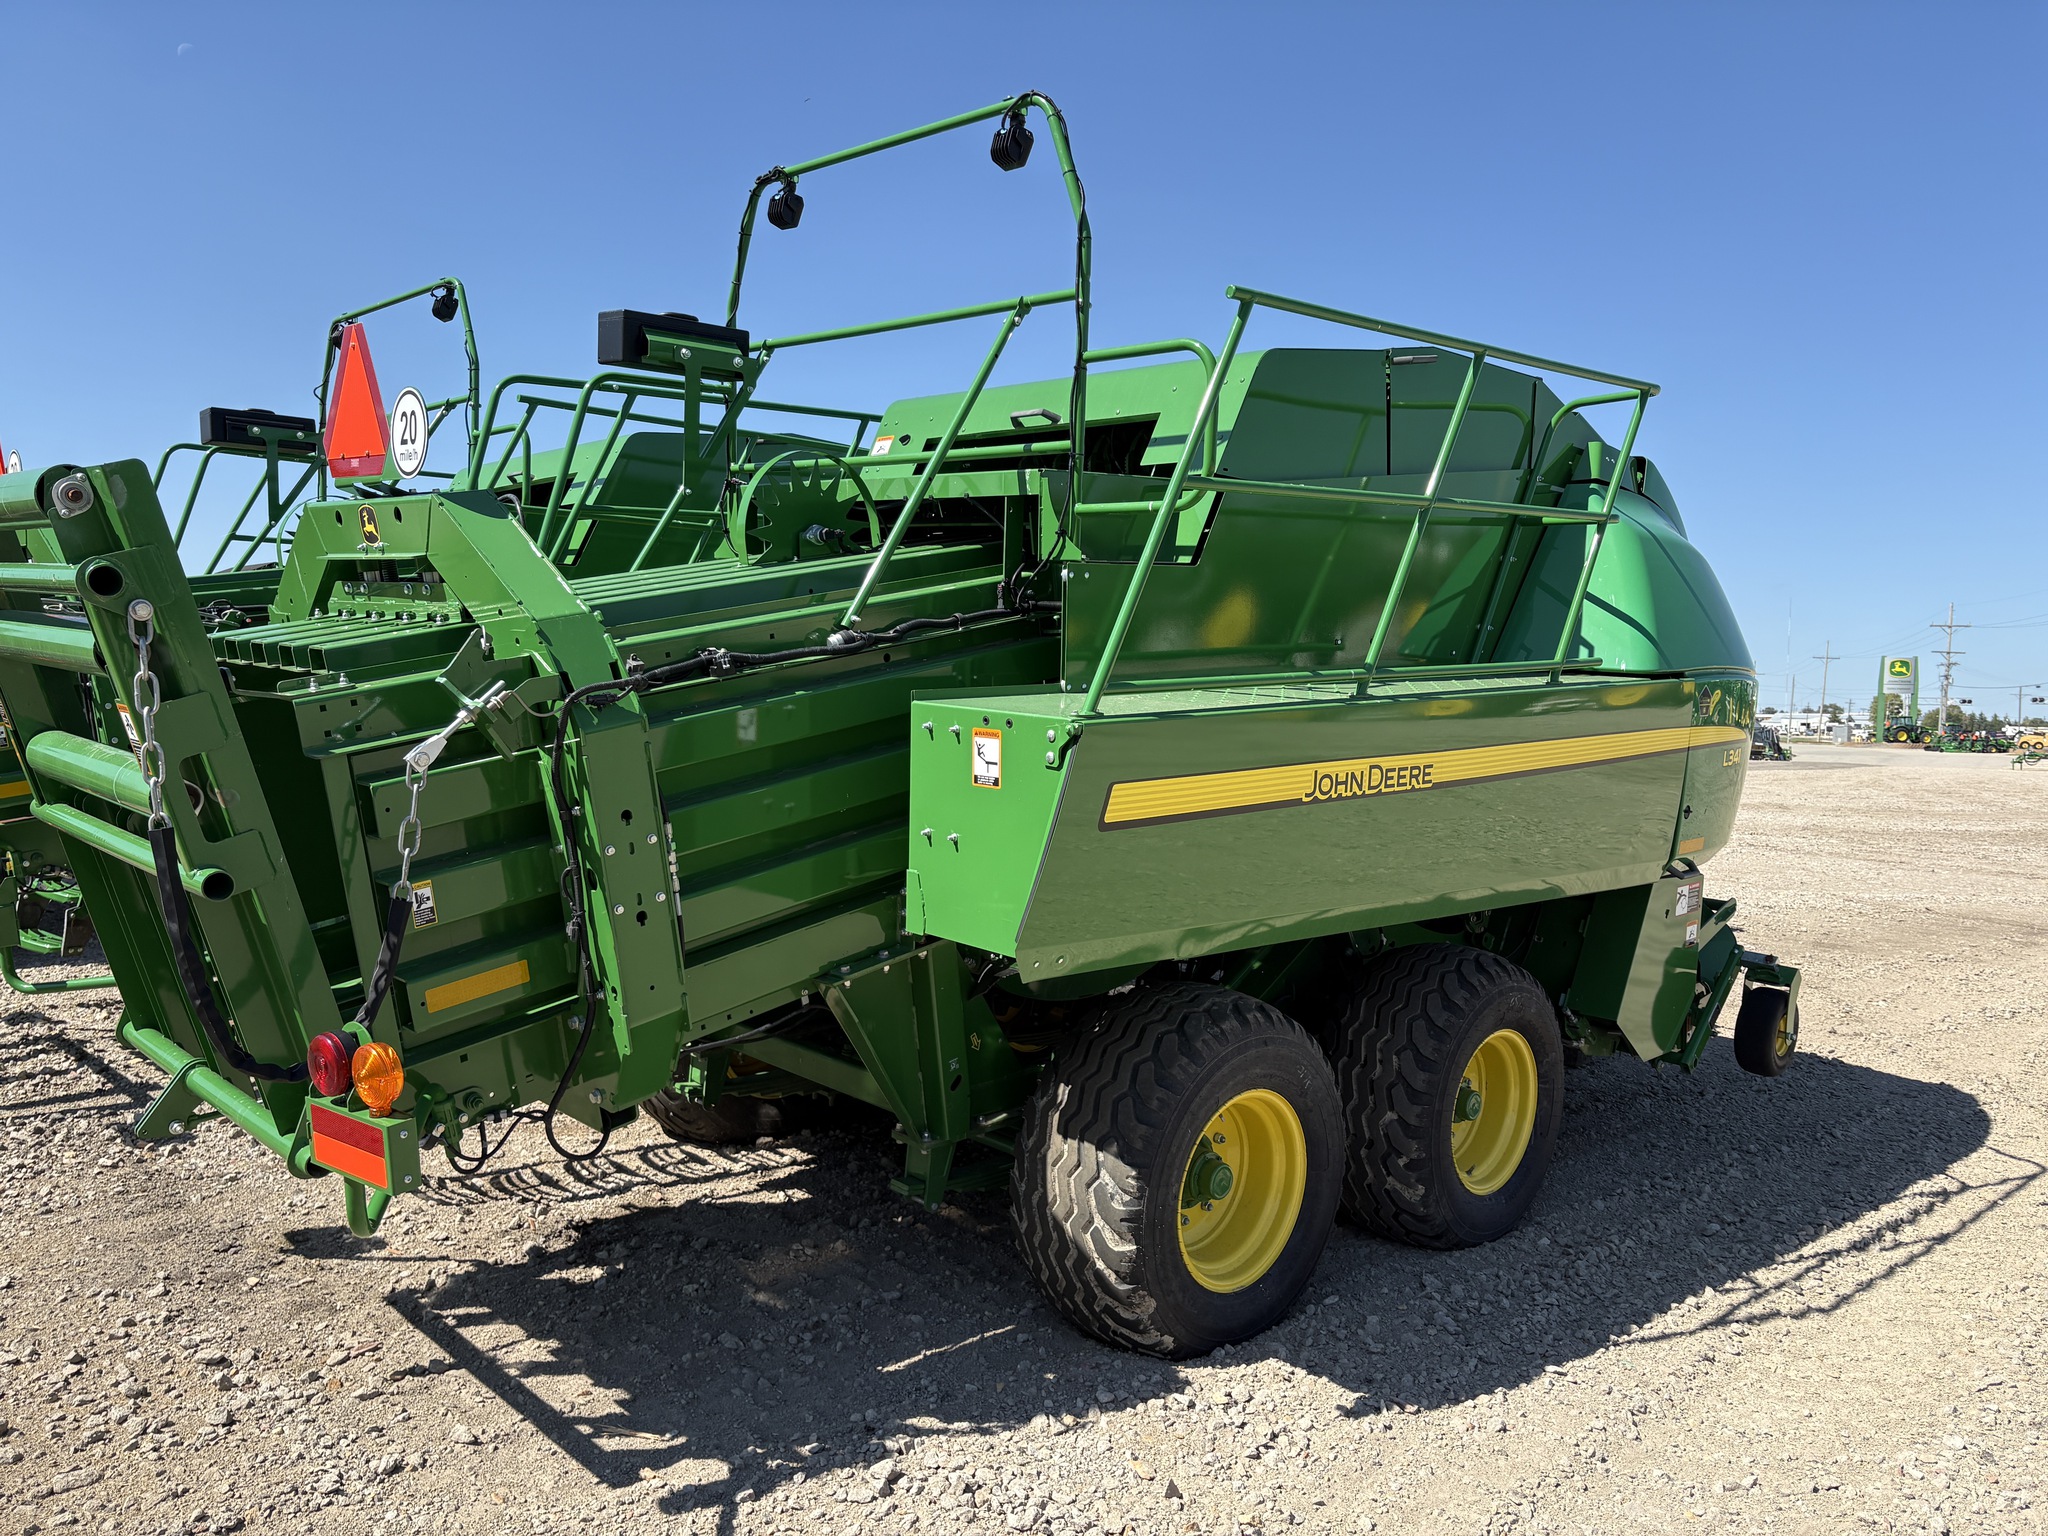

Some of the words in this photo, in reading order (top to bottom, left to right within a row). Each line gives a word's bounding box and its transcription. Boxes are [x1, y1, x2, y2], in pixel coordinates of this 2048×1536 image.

[400, 409, 418, 446] 20
[1303, 769, 1365, 800] JOHN
[1367, 763, 1435, 792] DEERE
